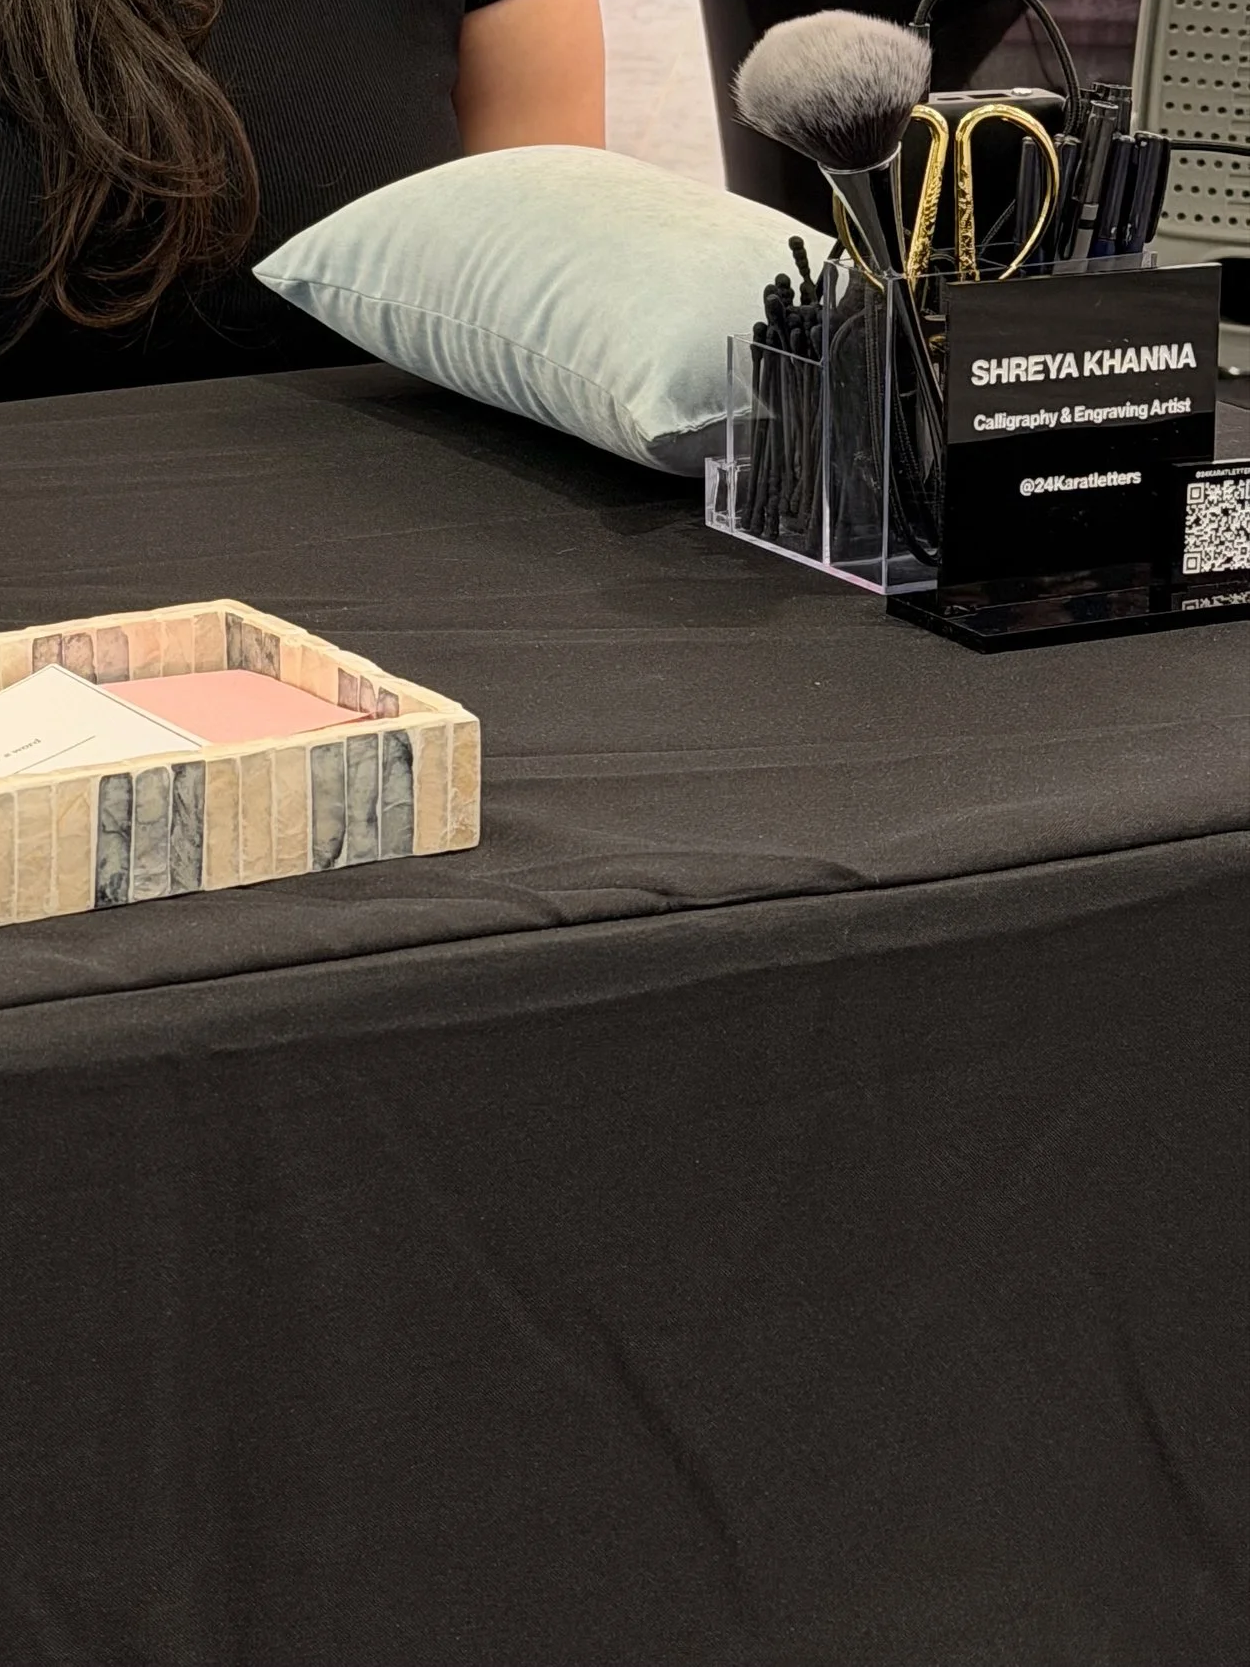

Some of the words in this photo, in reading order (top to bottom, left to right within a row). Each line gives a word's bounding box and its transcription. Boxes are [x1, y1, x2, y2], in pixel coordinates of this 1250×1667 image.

[971, 352, 1080, 386] SHREYA
[1083, 342, 1197, 376] KHANNA
[973, 409, 1059, 431] Calligraphy
[1060, 407, 1072, 423] &
[1074, 402, 1149, 424] Engraving
[1150, 397, 1192, 416] Artist
[1019, 471, 1142, 497] @24Karatletters
